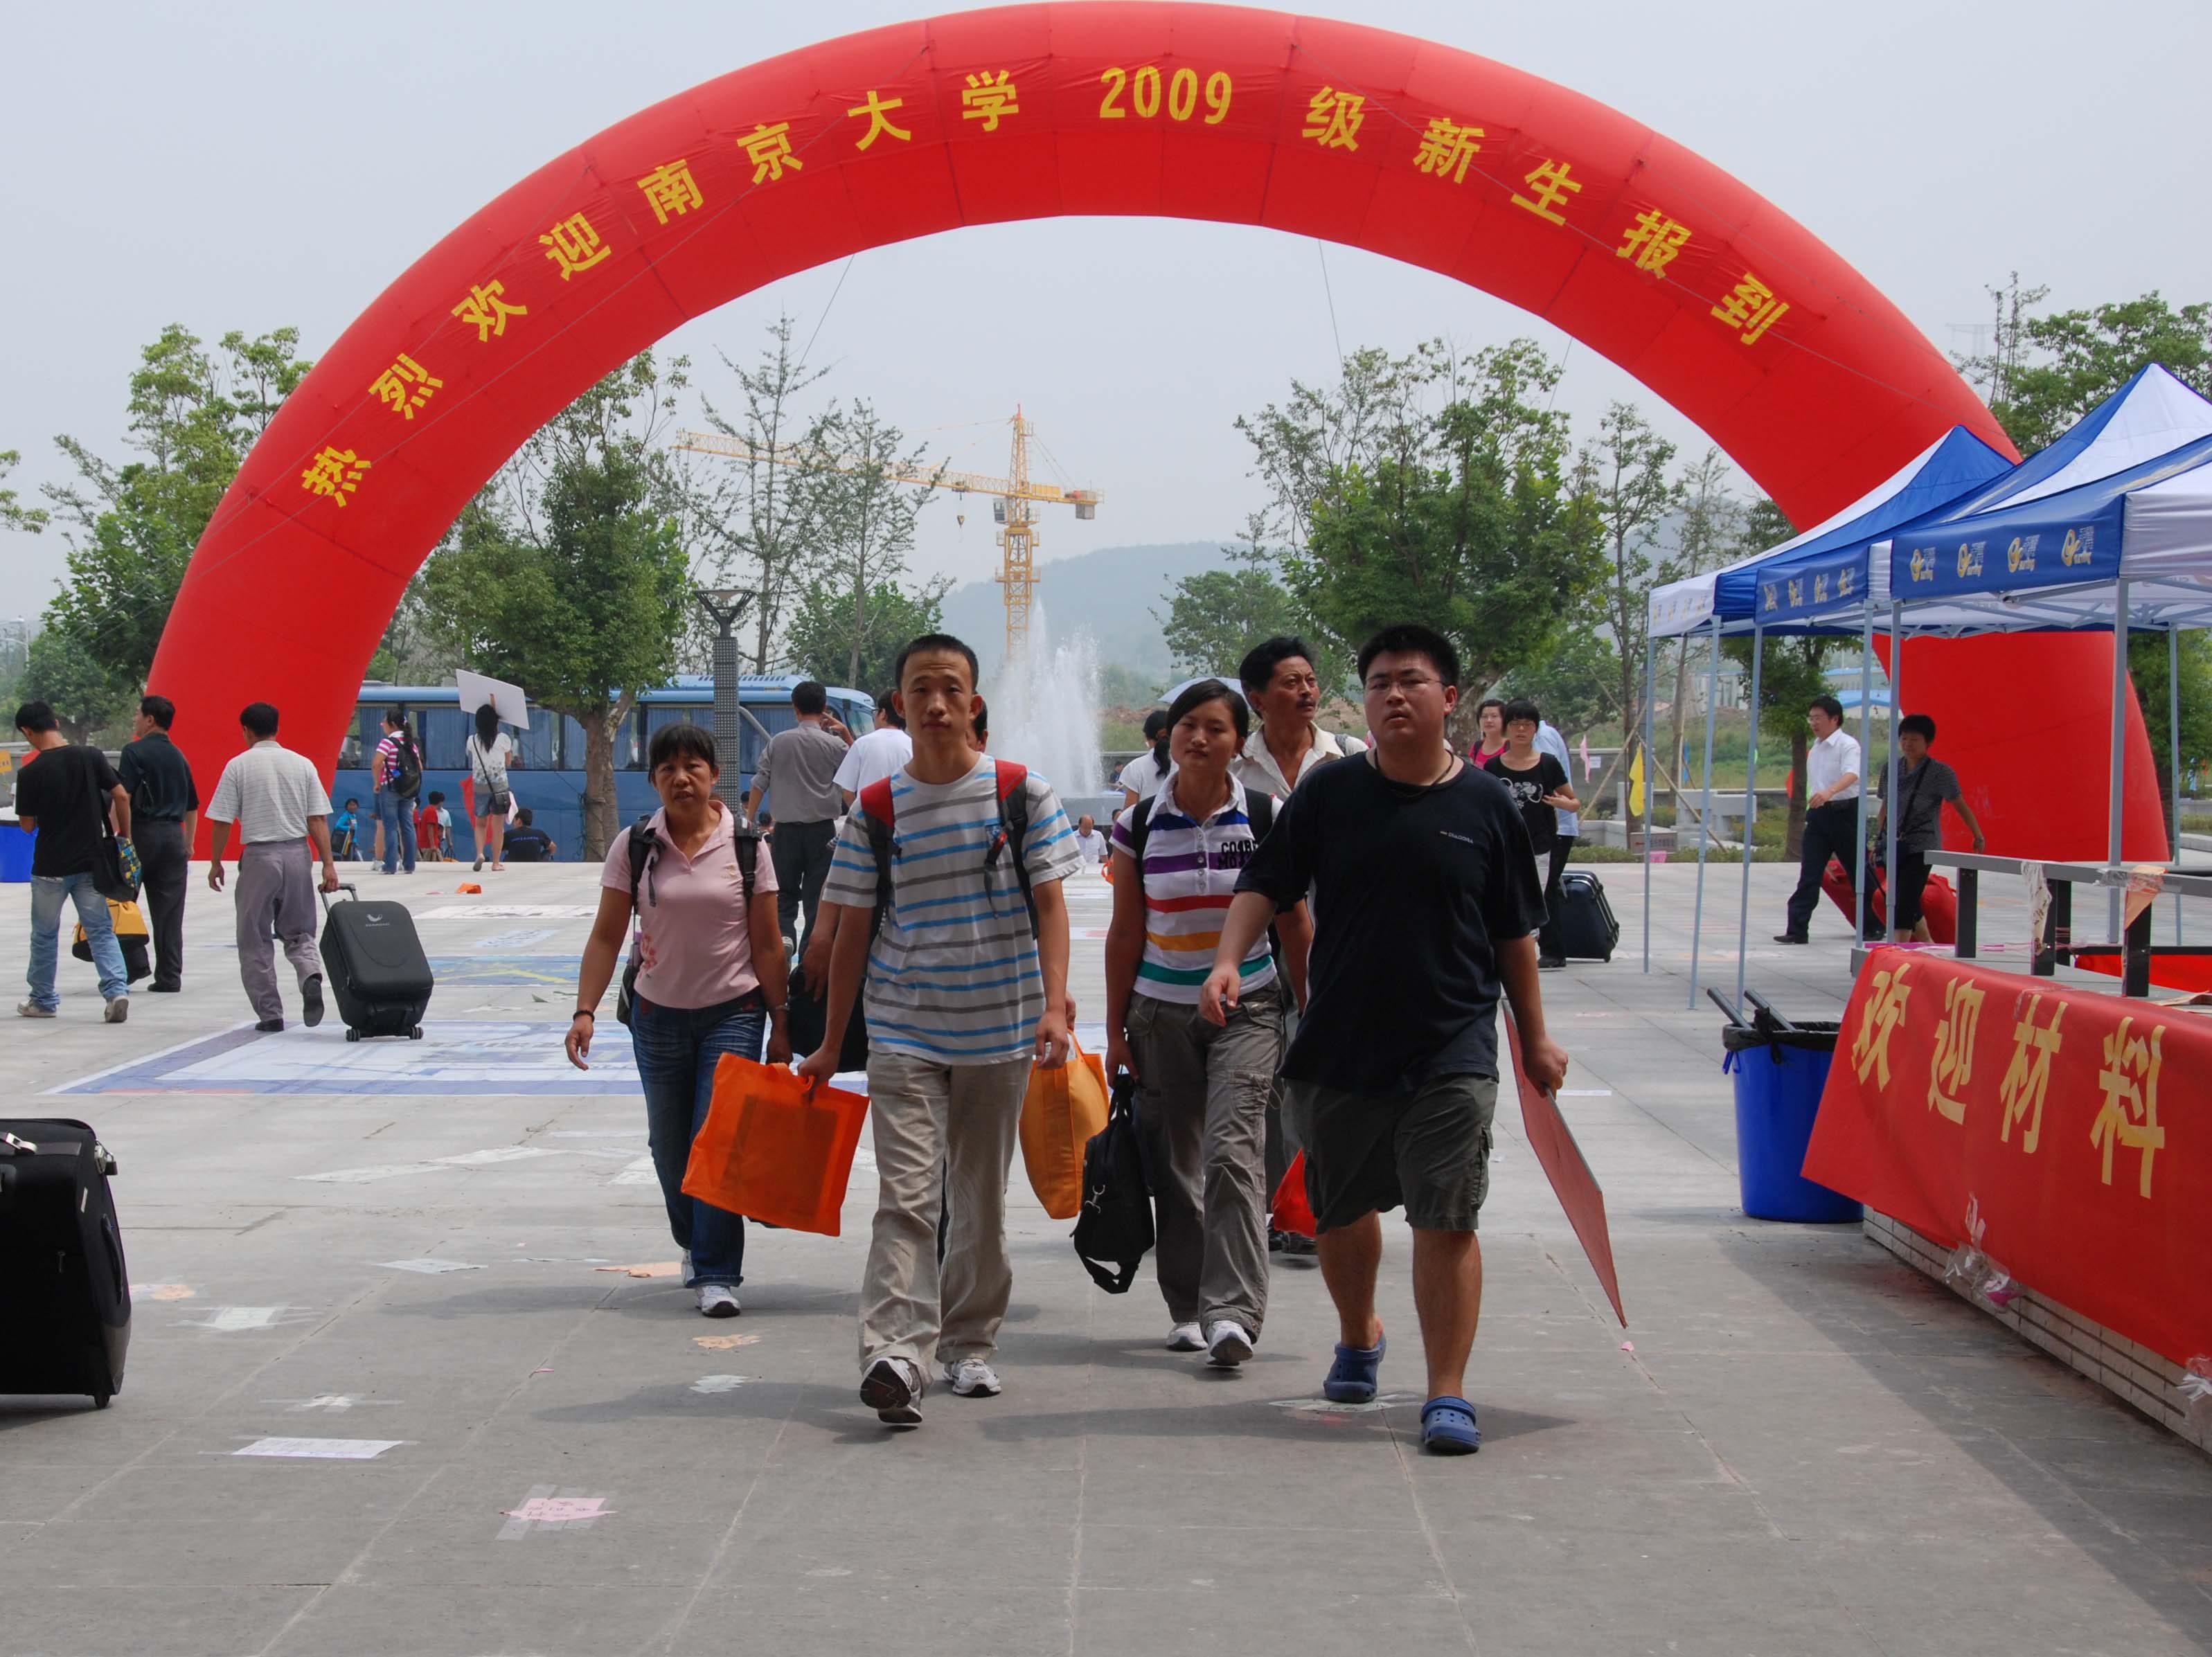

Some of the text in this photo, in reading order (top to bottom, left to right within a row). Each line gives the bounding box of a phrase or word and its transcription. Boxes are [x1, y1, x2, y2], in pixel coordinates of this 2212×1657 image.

[301, 66, 1789, 508] 热烈欢迎南京大学 2009 级新生报到
[1853, 963, 2166, 1199] 欢迎材料
